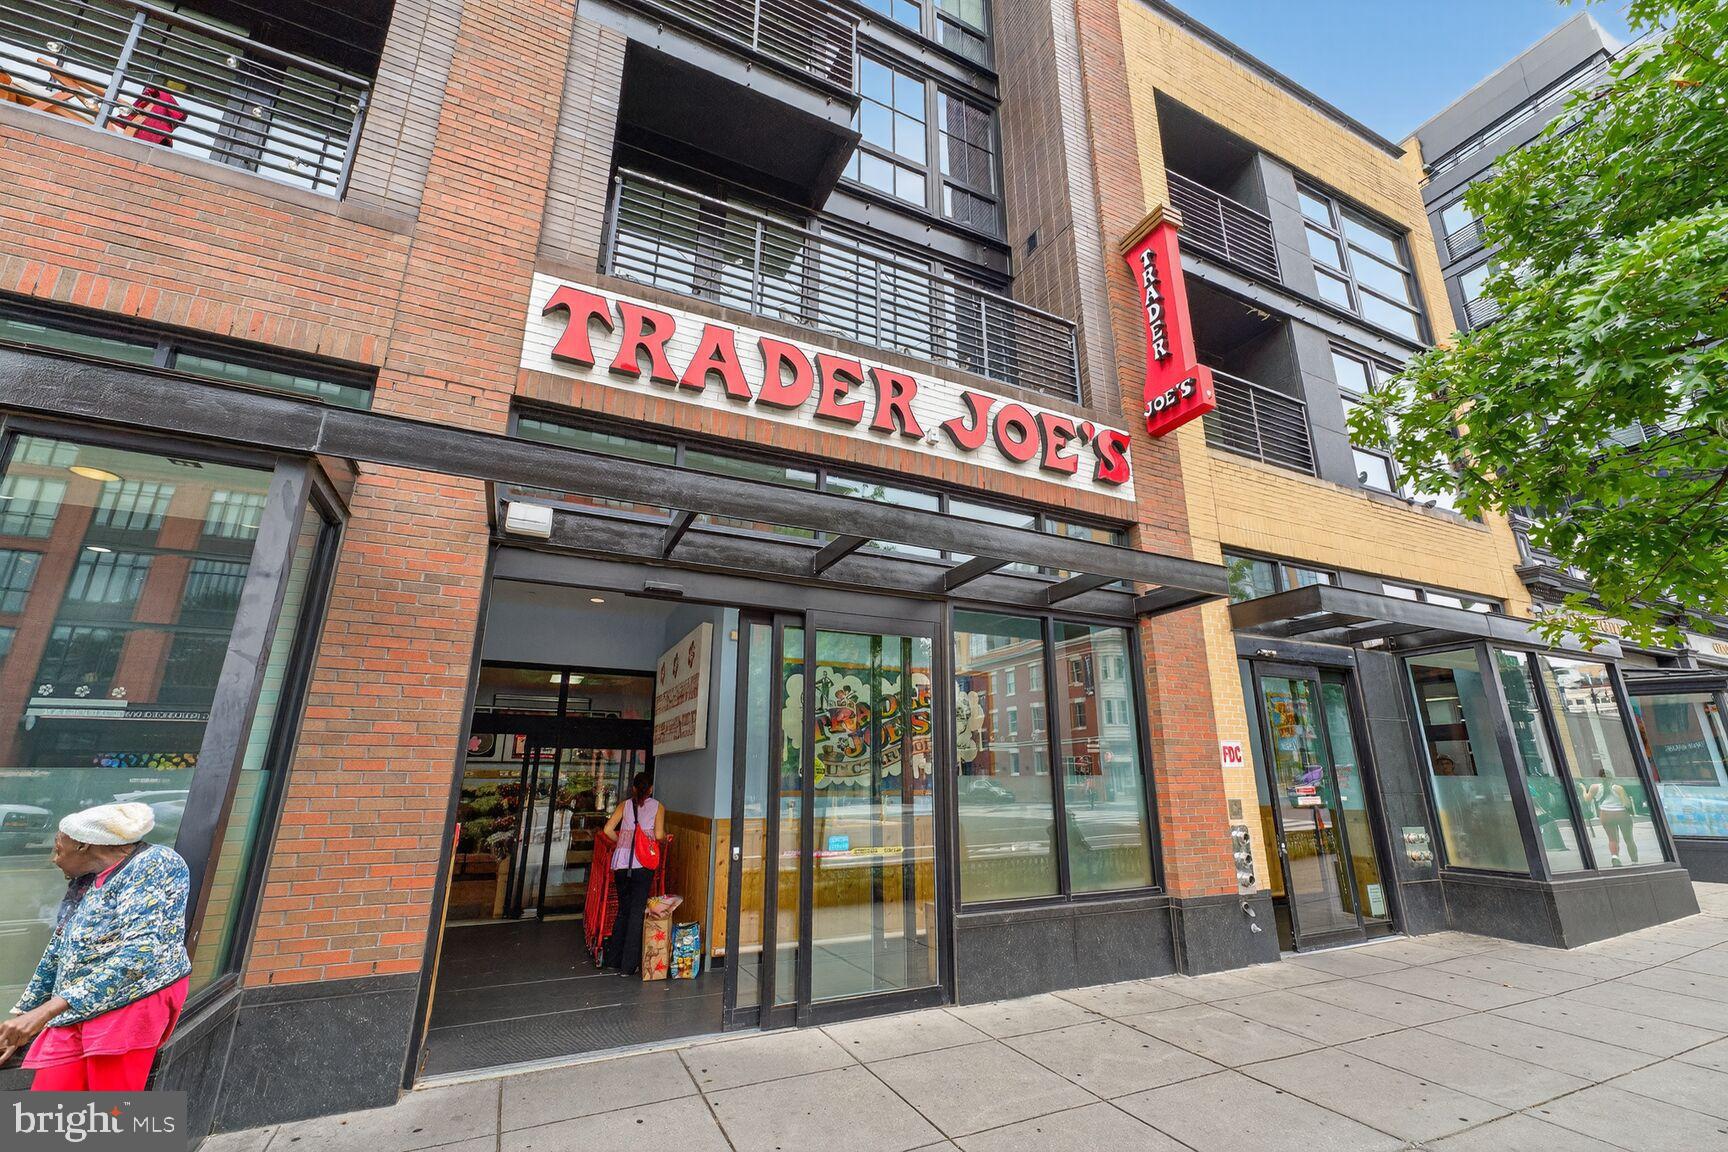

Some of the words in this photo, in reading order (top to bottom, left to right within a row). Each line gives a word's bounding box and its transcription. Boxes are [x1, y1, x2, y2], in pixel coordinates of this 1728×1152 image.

[1140, 248, 1172, 362] TRADER
[542, 285, 925, 440] TRADER
[940, 390, 1132, 486] JOE'S
[1144, 377, 1197, 418] JOE'S
[815, 684, 931, 743] TRADR
[1223, 745, 1242, 763] FDC
